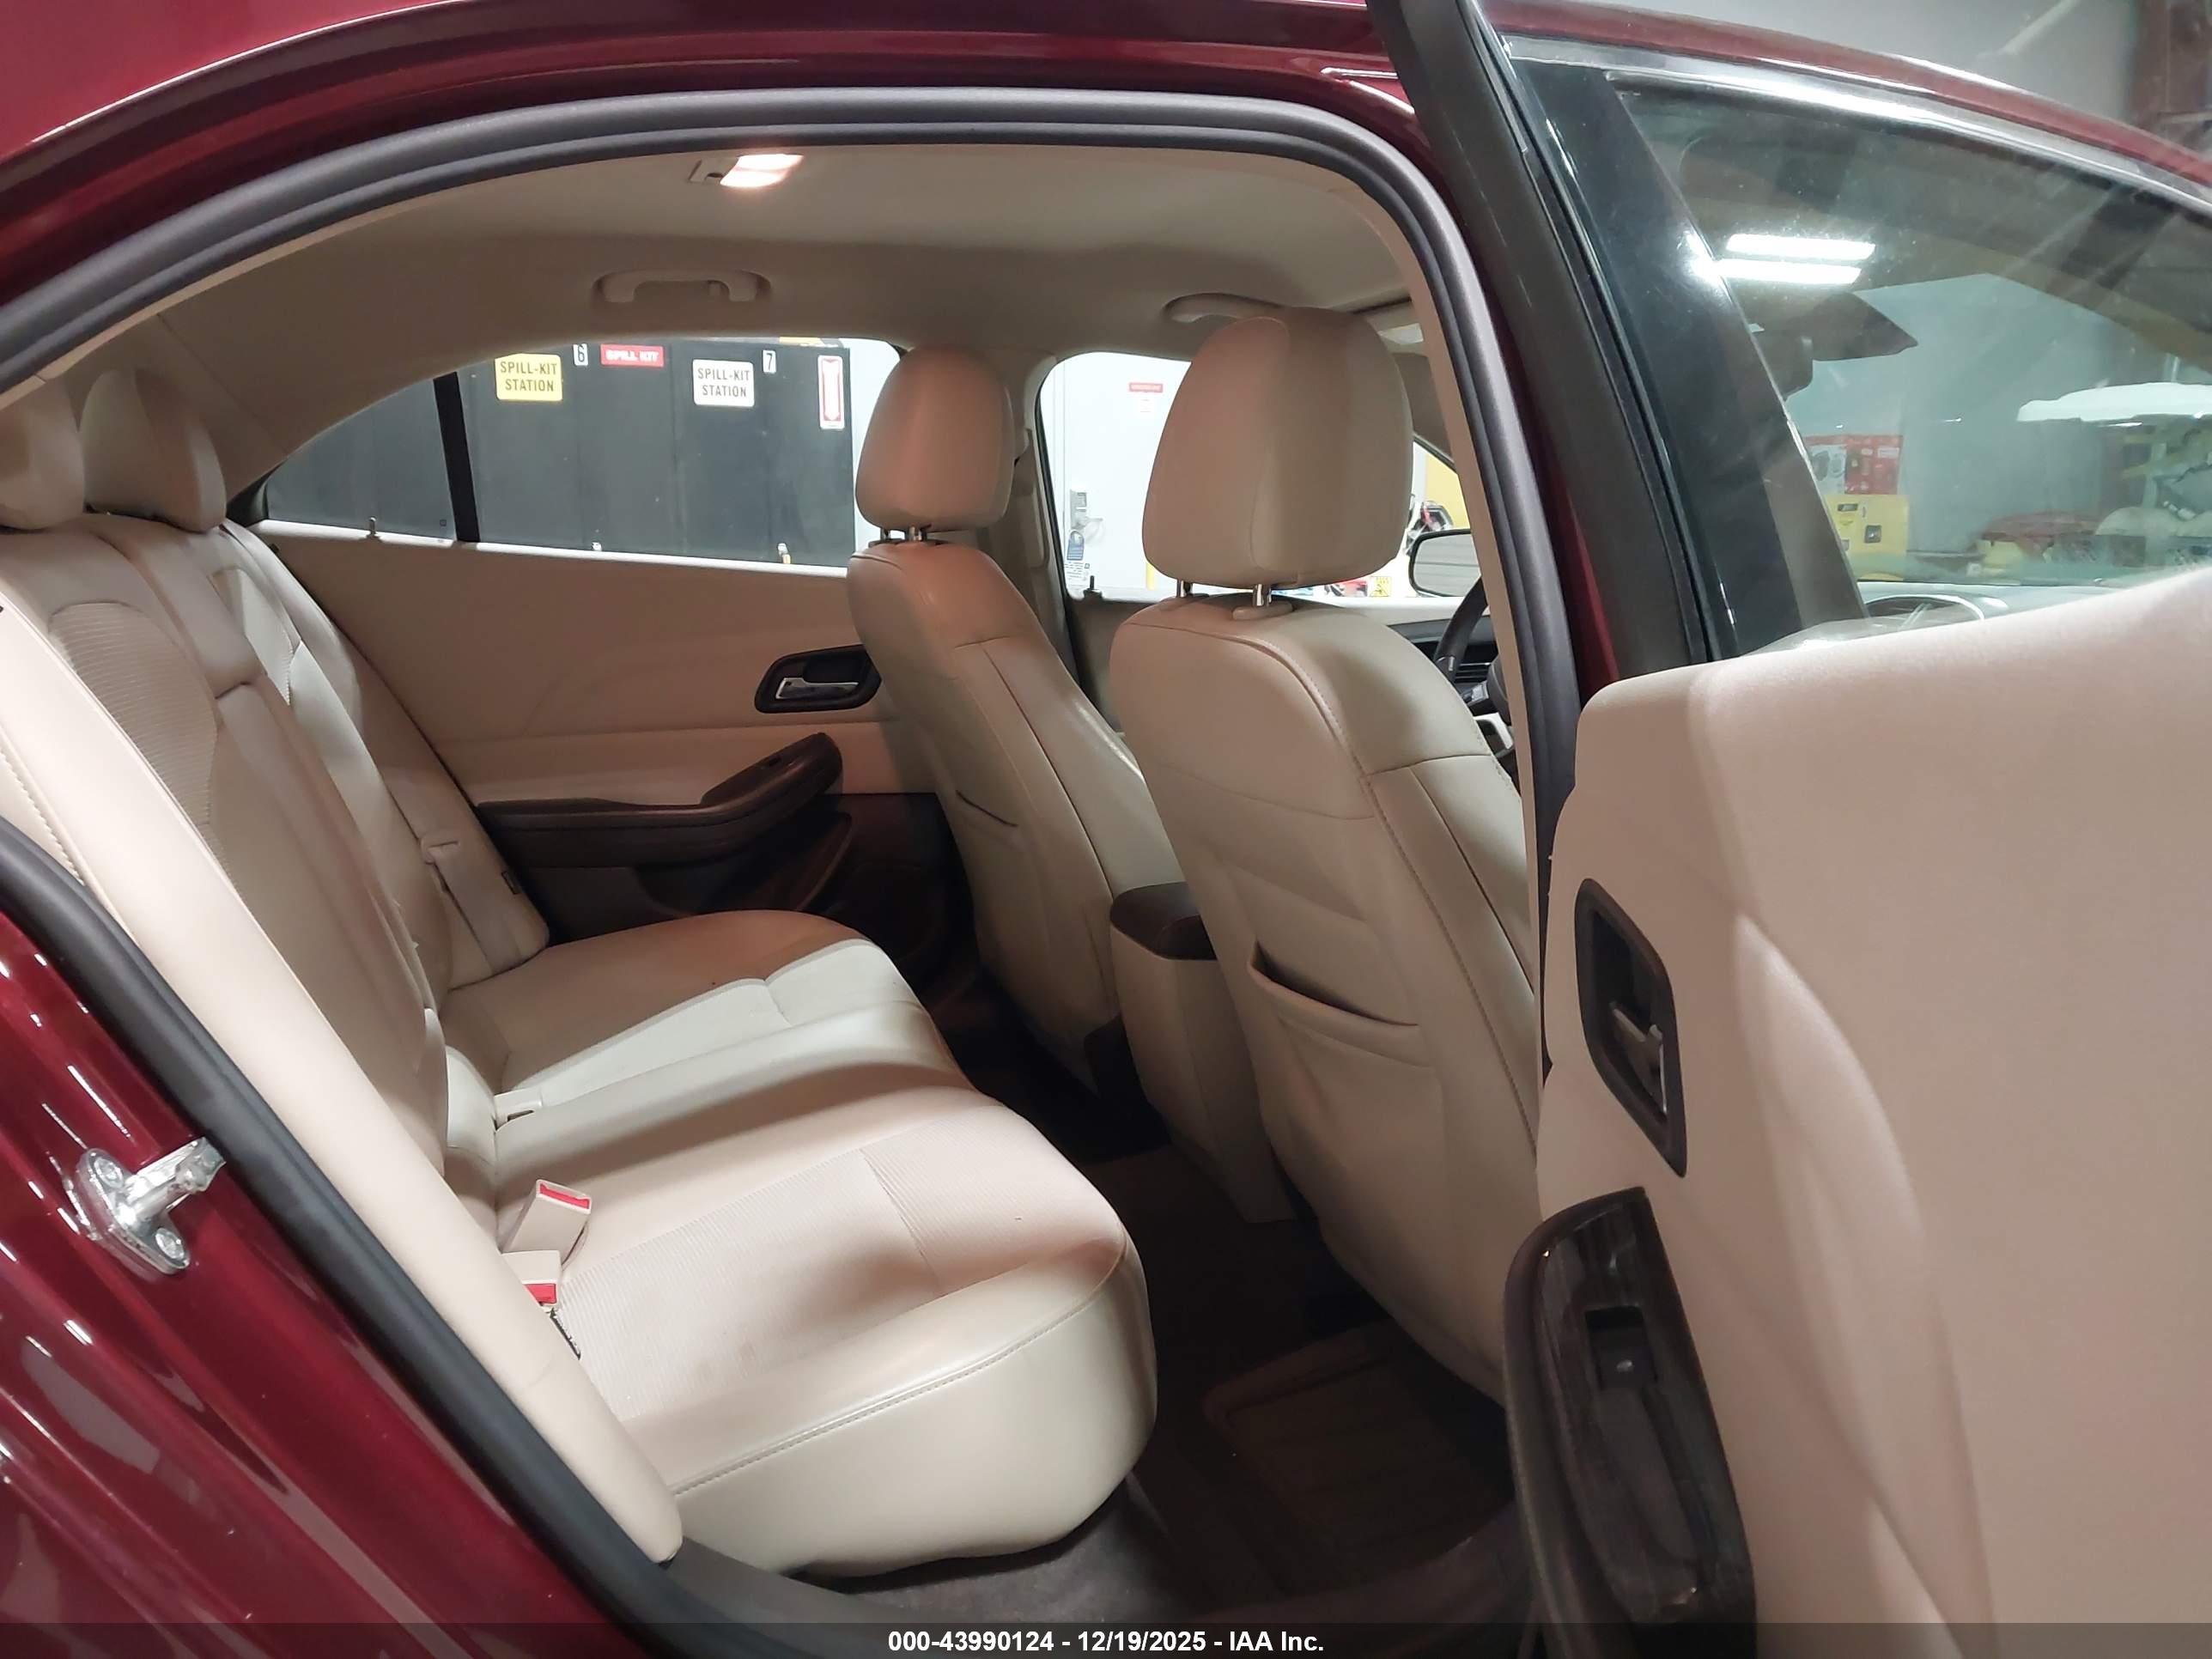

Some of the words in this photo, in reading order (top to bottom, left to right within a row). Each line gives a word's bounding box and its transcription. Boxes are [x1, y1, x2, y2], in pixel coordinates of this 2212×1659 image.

[577, 344, 586, 362] 6
[605, 349, 638, 362] SPILL
[639, 350, 659, 362] KIT
[766, 352, 773, 371] 7
[500, 362, 557, 376] SPILL-KIT
[697, 368, 750, 381] SPILL-KIT
[505, 378, 555, 392] STATION
[702, 385, 747, 397] STATION
